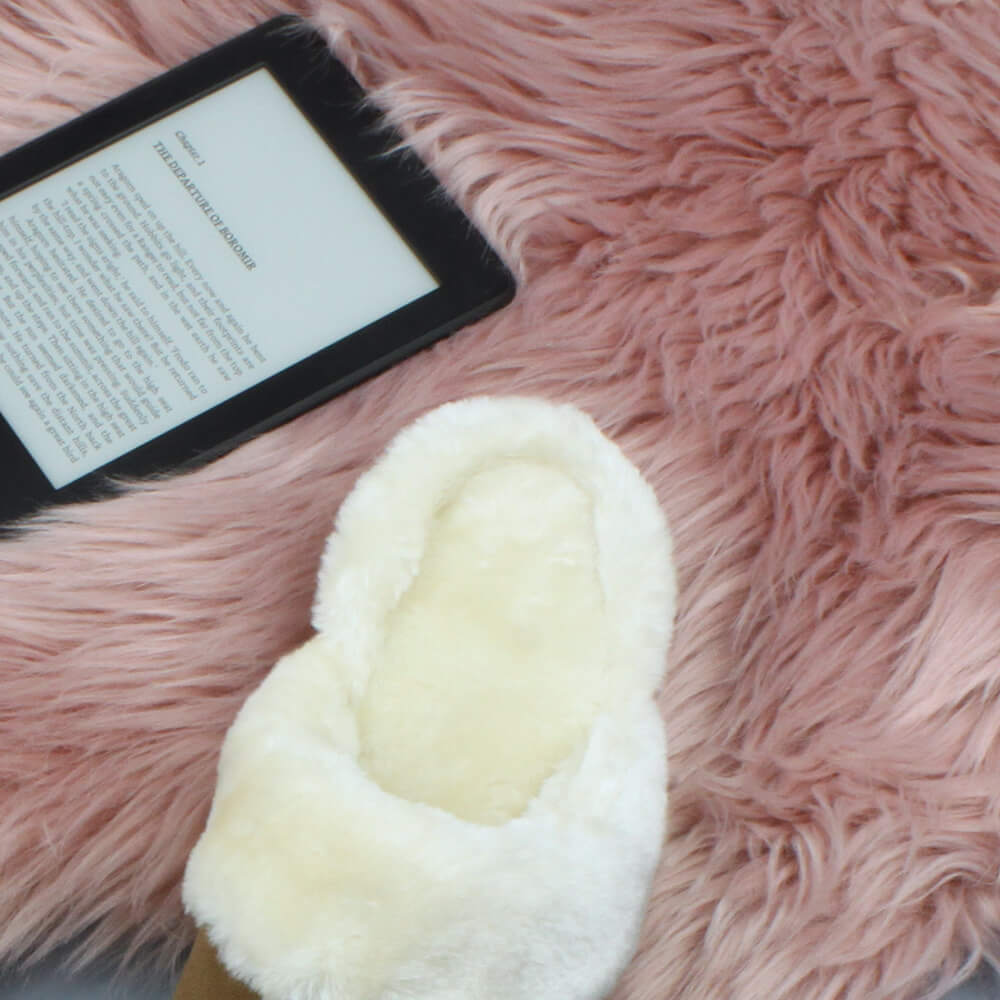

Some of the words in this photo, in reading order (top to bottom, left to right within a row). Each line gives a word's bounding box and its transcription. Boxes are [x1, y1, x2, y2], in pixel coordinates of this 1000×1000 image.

[151, 140, 174, 162] THE
[166, 159, 215, 216] DEPARTURE
[207, 212, 224, 228] OF
[217, 225, 258, 272] BOROMIR
